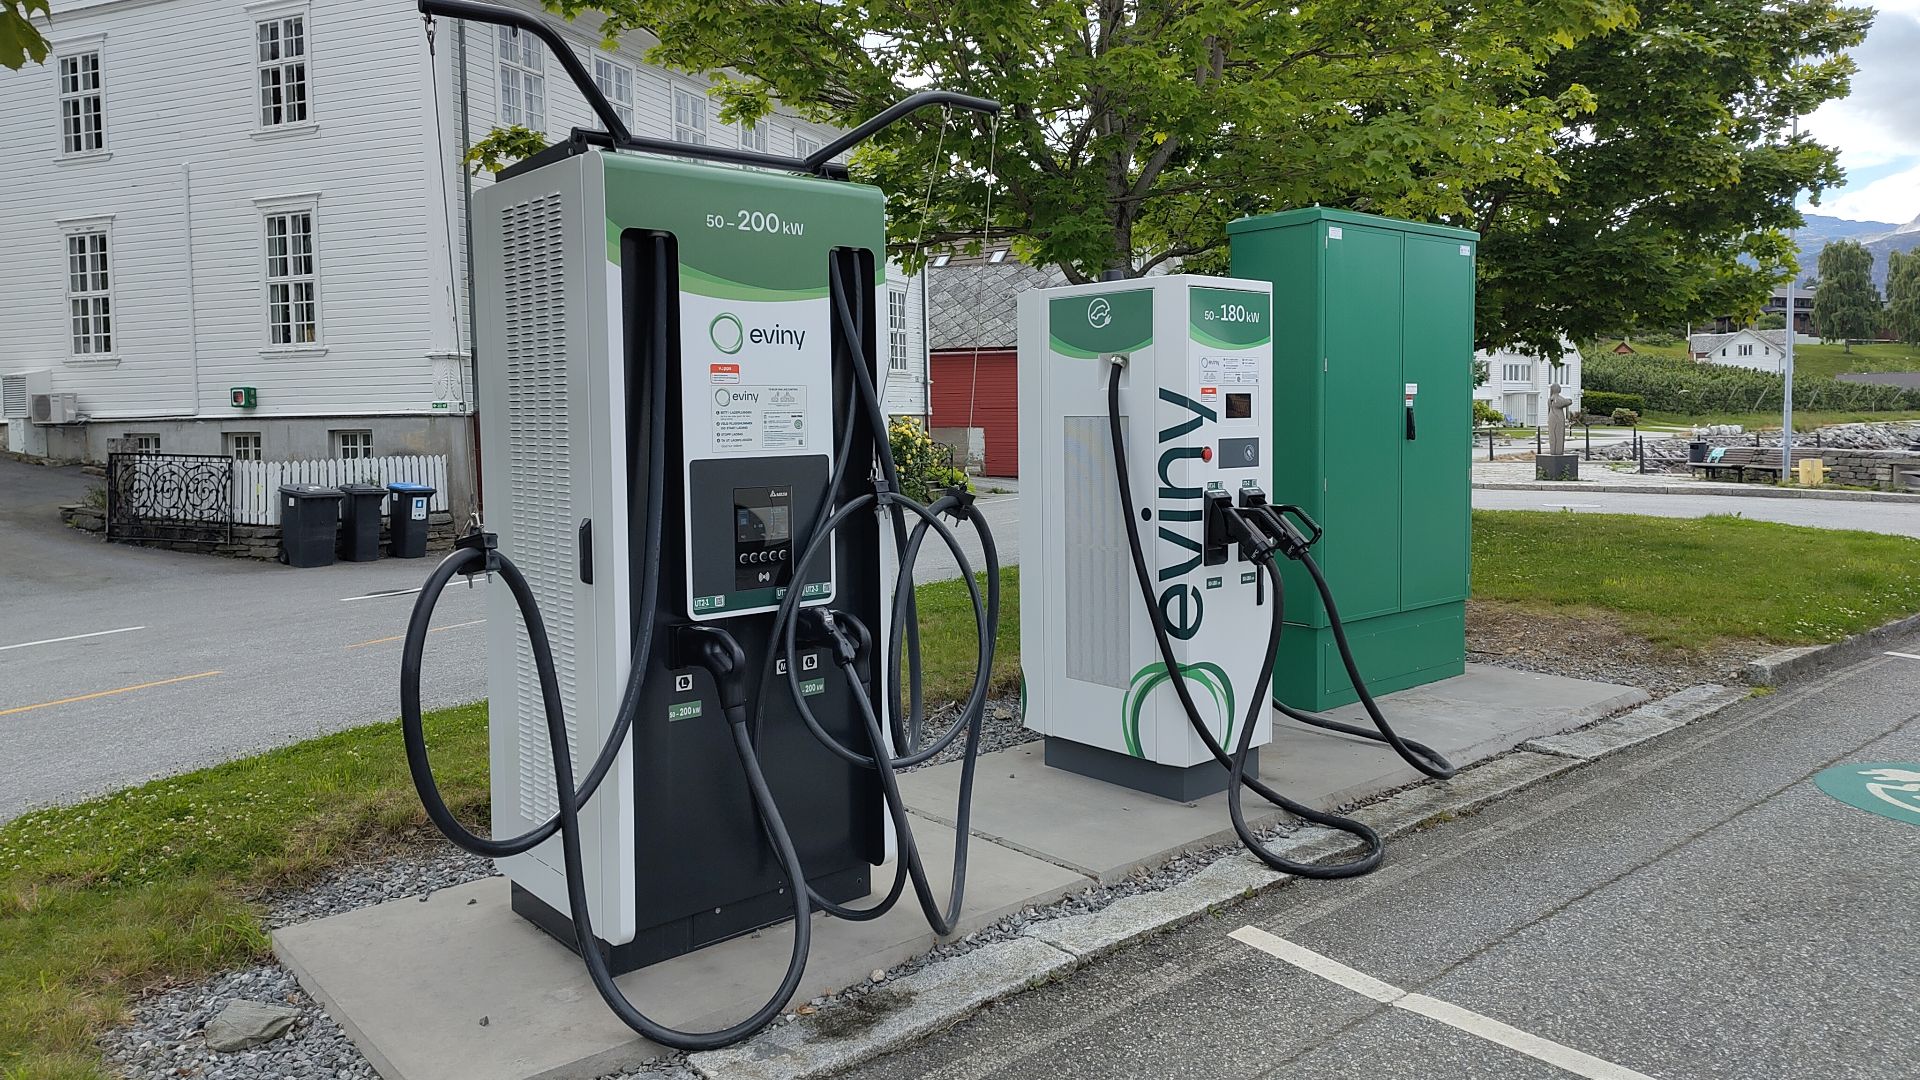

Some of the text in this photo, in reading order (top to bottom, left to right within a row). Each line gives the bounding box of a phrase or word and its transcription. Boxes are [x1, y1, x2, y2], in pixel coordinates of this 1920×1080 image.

[782, 221, 804, 236] kW
[1246, 311, 1260, 323] kW
[749, 324, 805, 350] eviny
[732, 390, 759, 403] eviny
[1141, 387, 1217, 640] eviny
[694, 598, 710, 608] UT2-1
